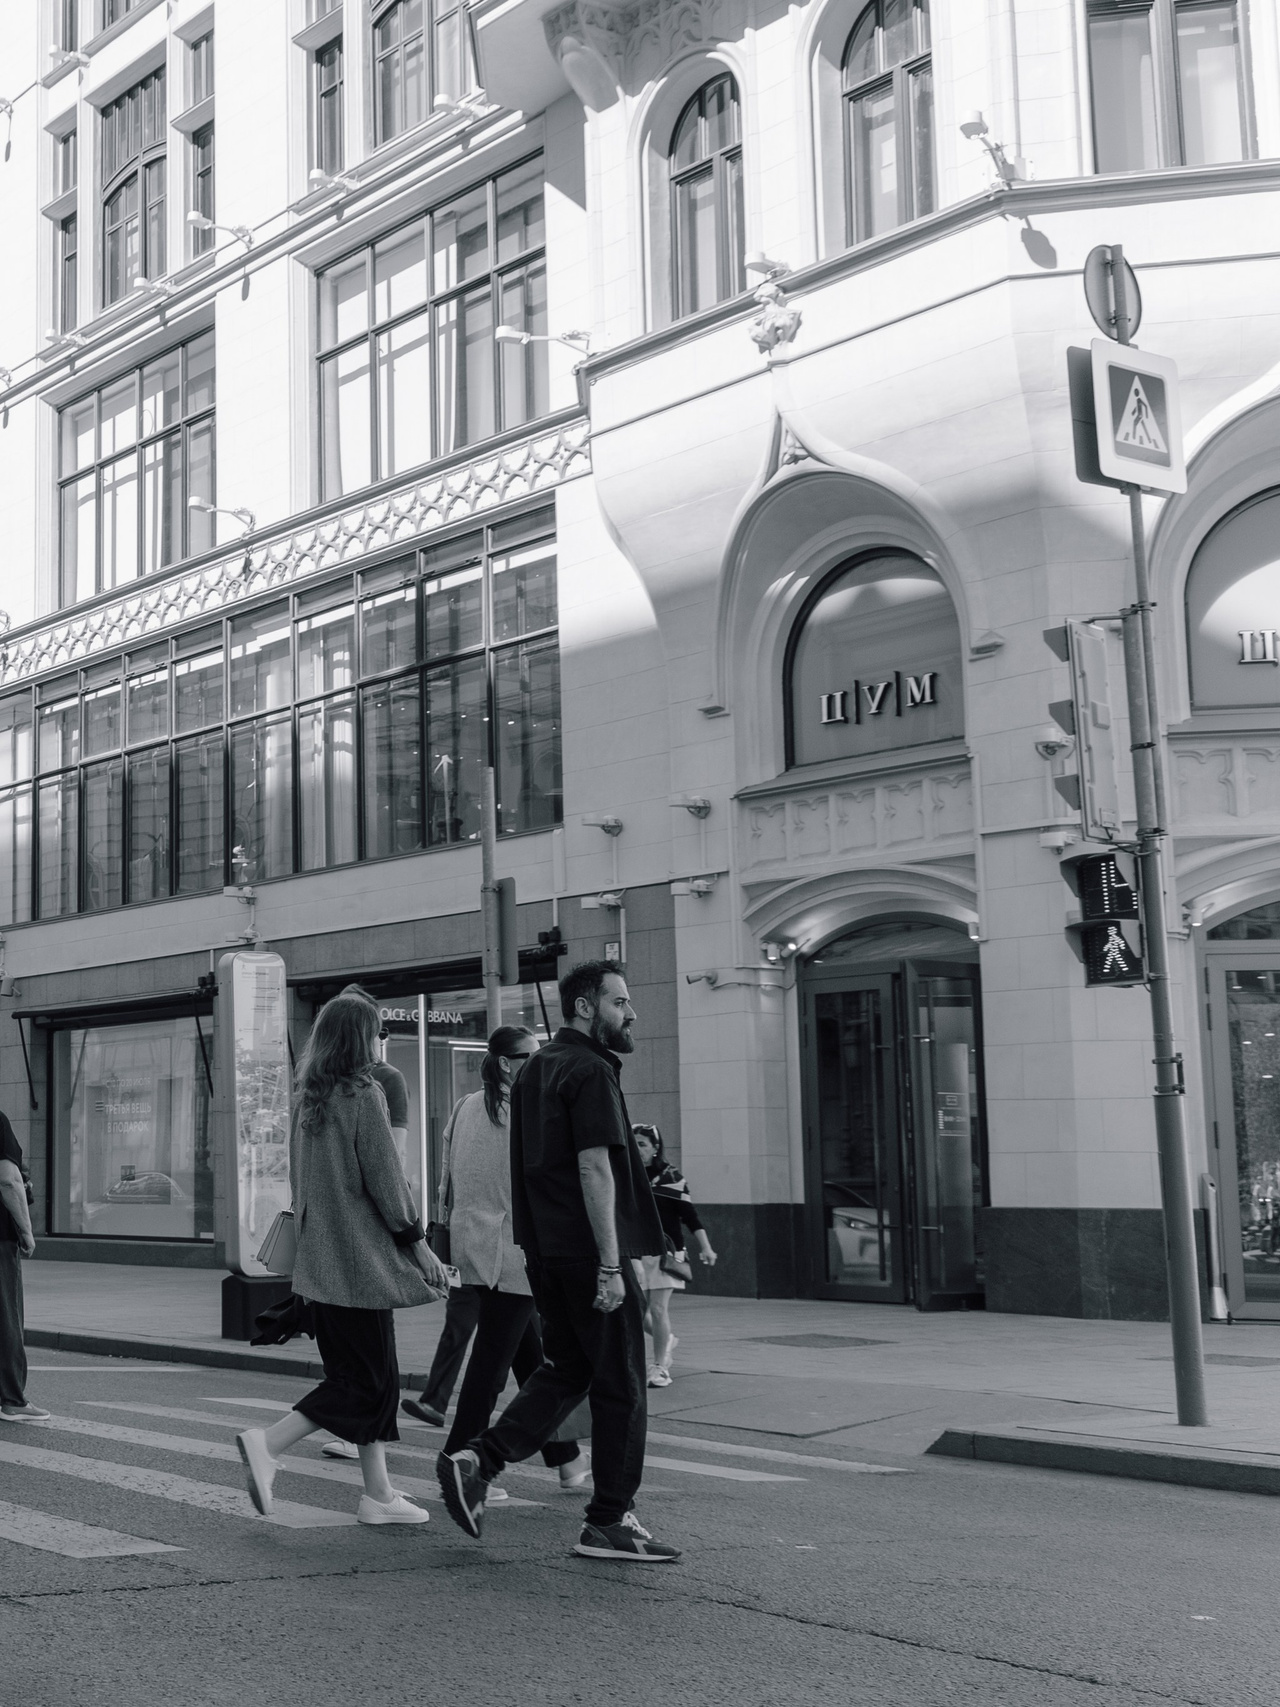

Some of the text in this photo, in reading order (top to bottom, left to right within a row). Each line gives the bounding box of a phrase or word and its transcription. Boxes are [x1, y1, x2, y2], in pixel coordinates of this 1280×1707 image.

[105, 1102, 152, 1115] ТРЕТЬЯ ВЕЩЬ
[107, 1121, 149, 1134] В ПОДАРОК
